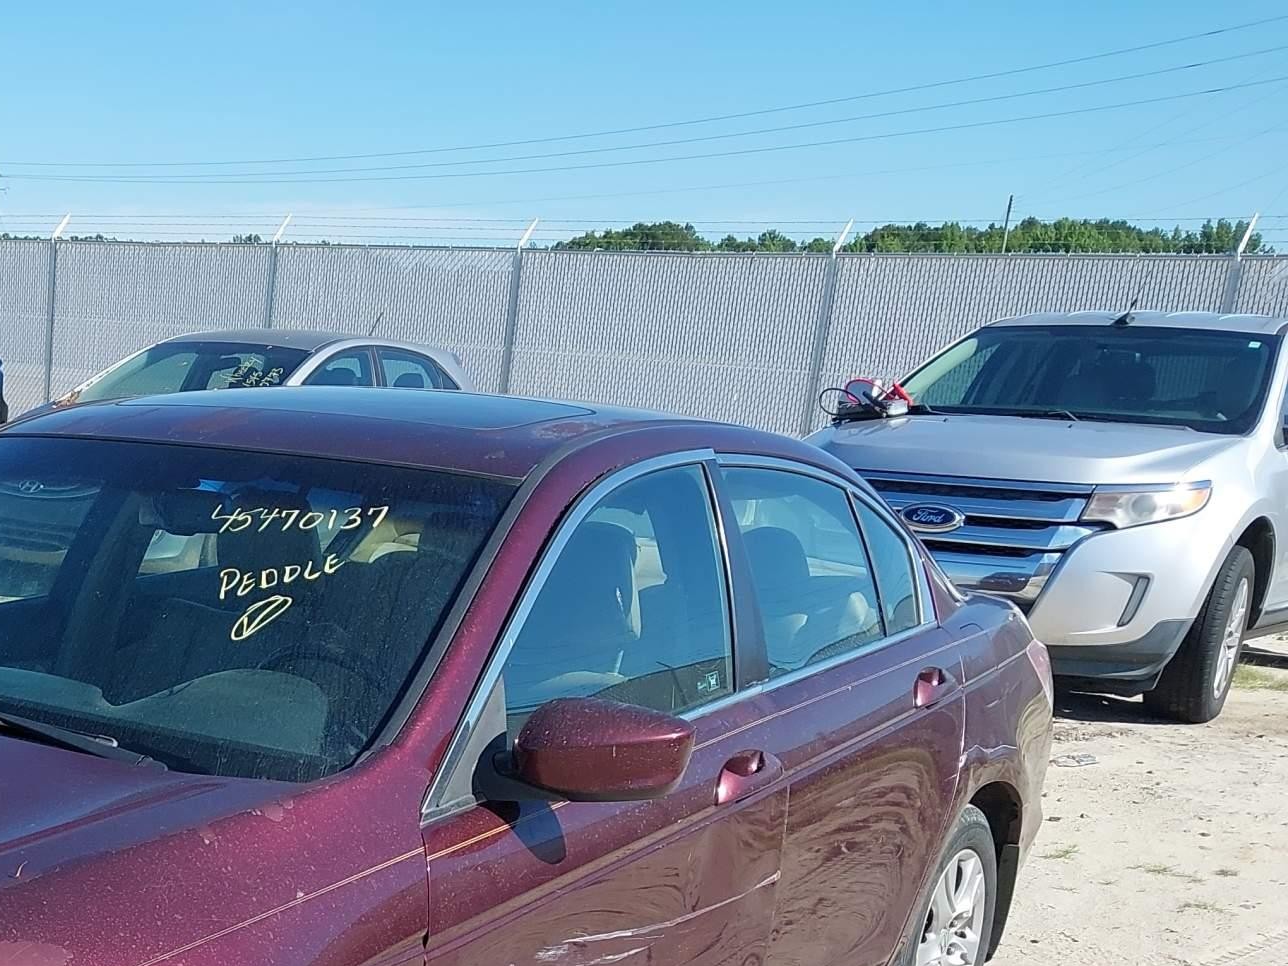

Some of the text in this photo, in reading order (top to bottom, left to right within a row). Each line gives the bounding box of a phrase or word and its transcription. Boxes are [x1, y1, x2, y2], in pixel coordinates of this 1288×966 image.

[211, 504, 389, 533] 45470137
[912, 508, 946, 523] Ford
[219, 553, 346, 600] PEDDLE
